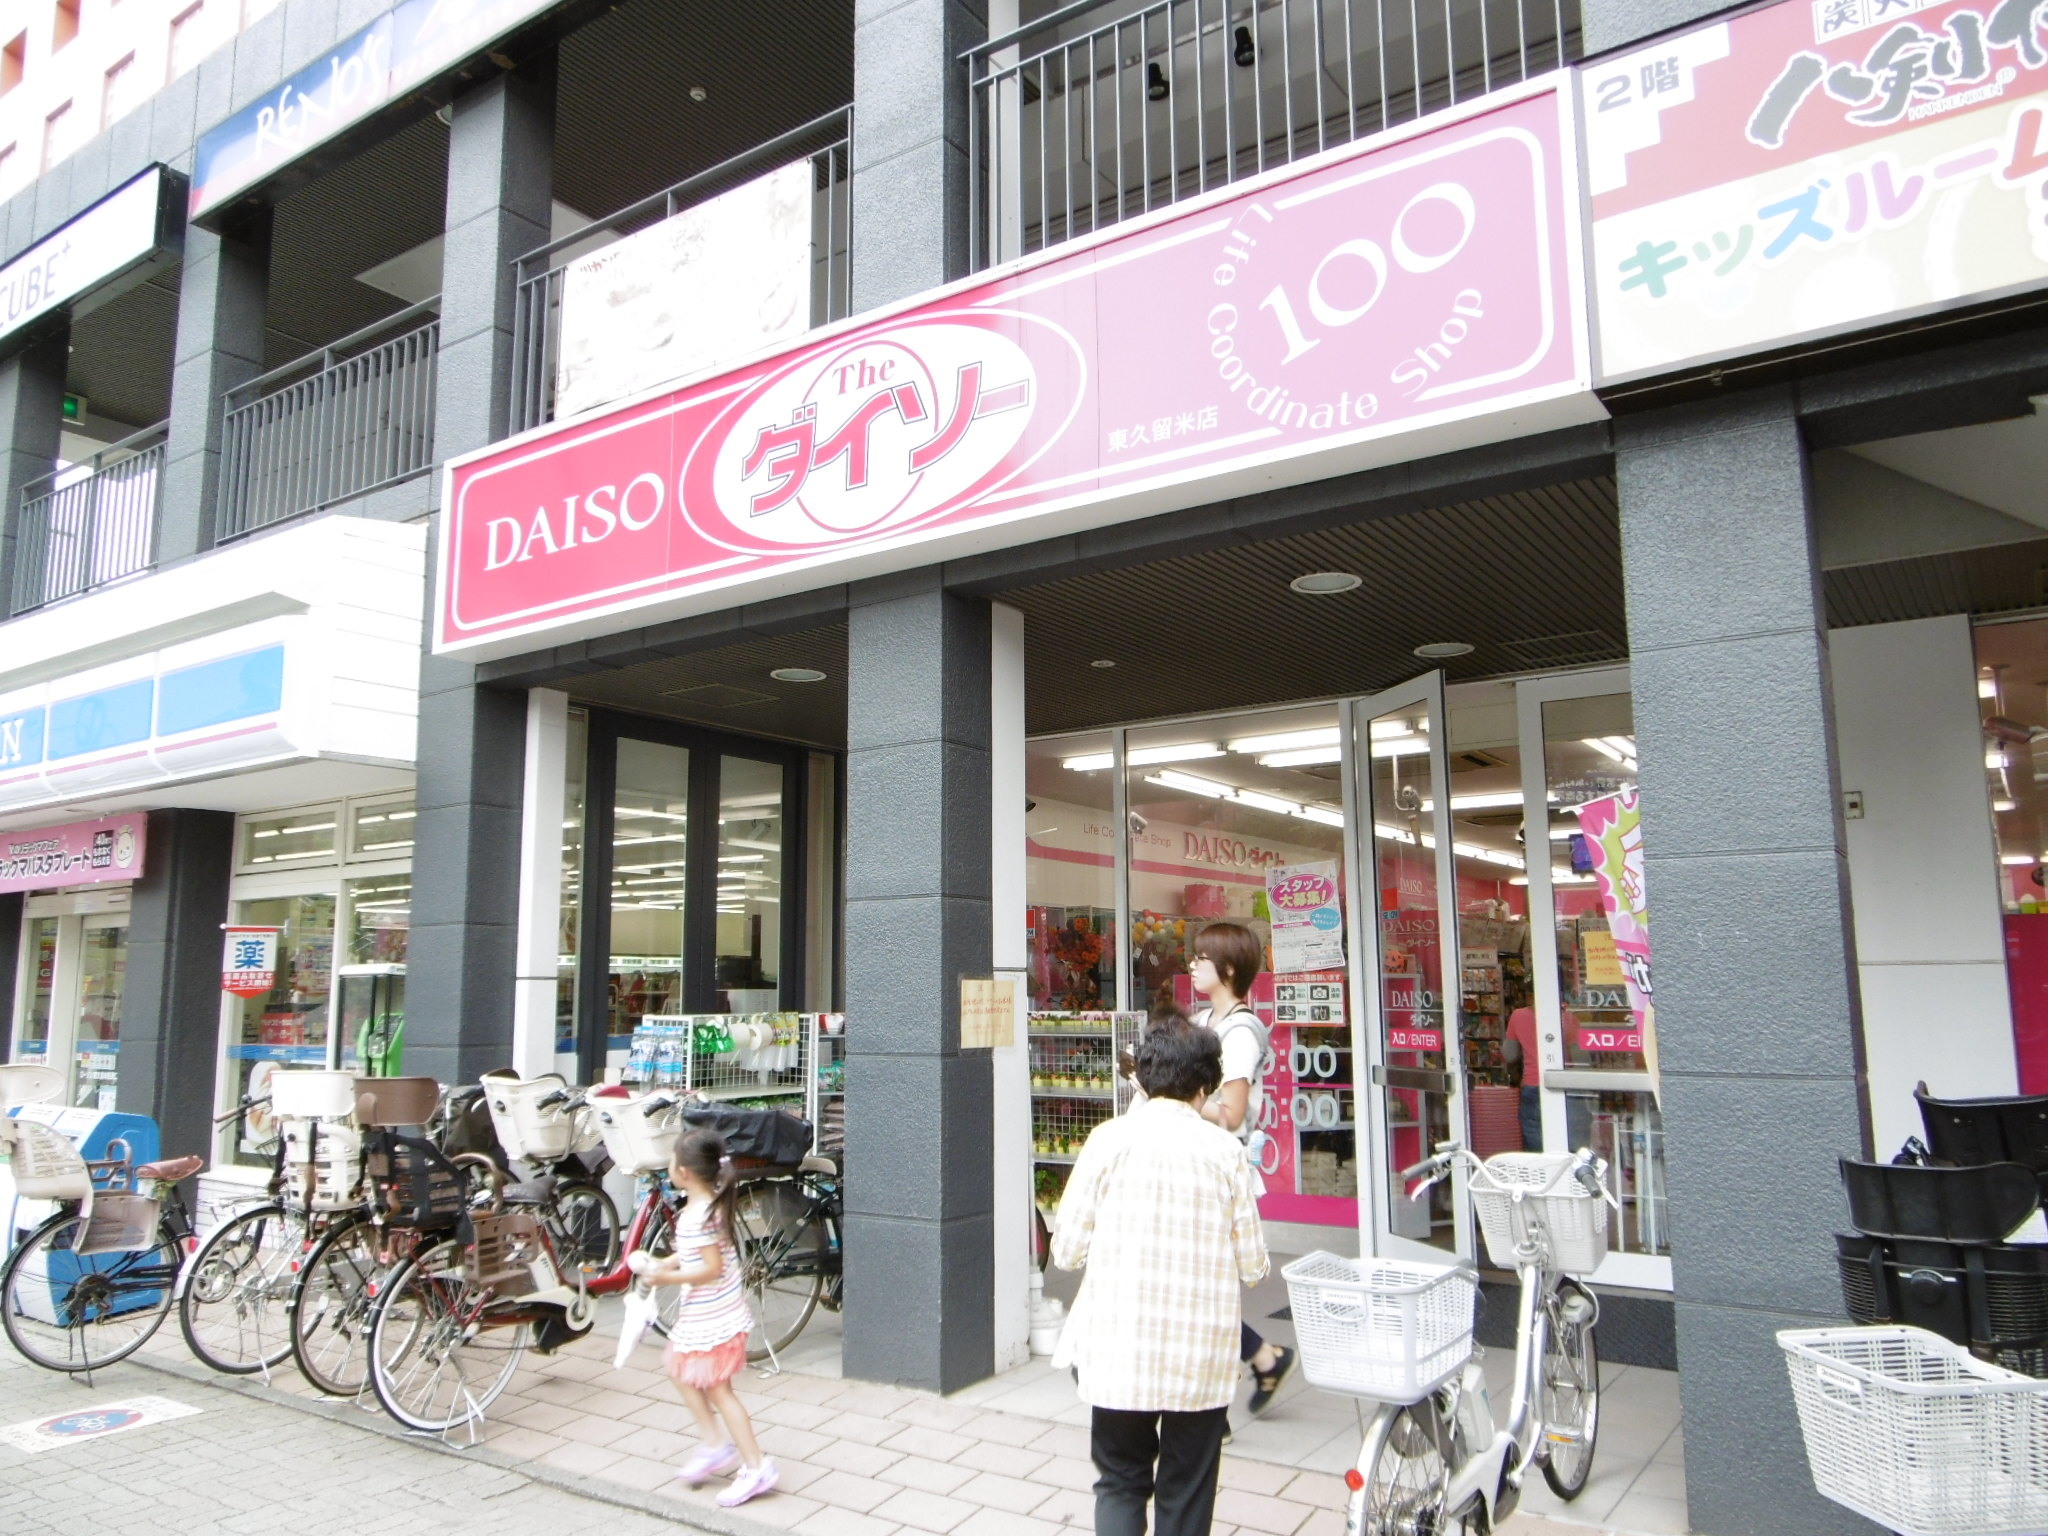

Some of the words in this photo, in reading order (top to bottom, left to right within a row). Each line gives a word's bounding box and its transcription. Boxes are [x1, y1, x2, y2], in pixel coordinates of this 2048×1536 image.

[1596, 56, 1680, 113] 2階
[1213, 203, 1274, 287] Life
[1258, 182, 1476, 365] 100
[1208, 303, 1379, 430] Coordinate
[1390, 288, 1484, 398] Shop
[833, 358, 897, 396] The
[741, 361, 1030, 518] ダイソー
[1107, 405, 1219, 453] 東久留米店
[483, 472, 666, 571] DAISO
[1184, 831, 1247, 868] DAISO
[1279, 876, 1325, 893] スタッフ
[235, 940, 265, 969] 薬
[1392, 990, 1433, 1008] DAISO
[1410, 1013, 1434, 1026] ダイソー
